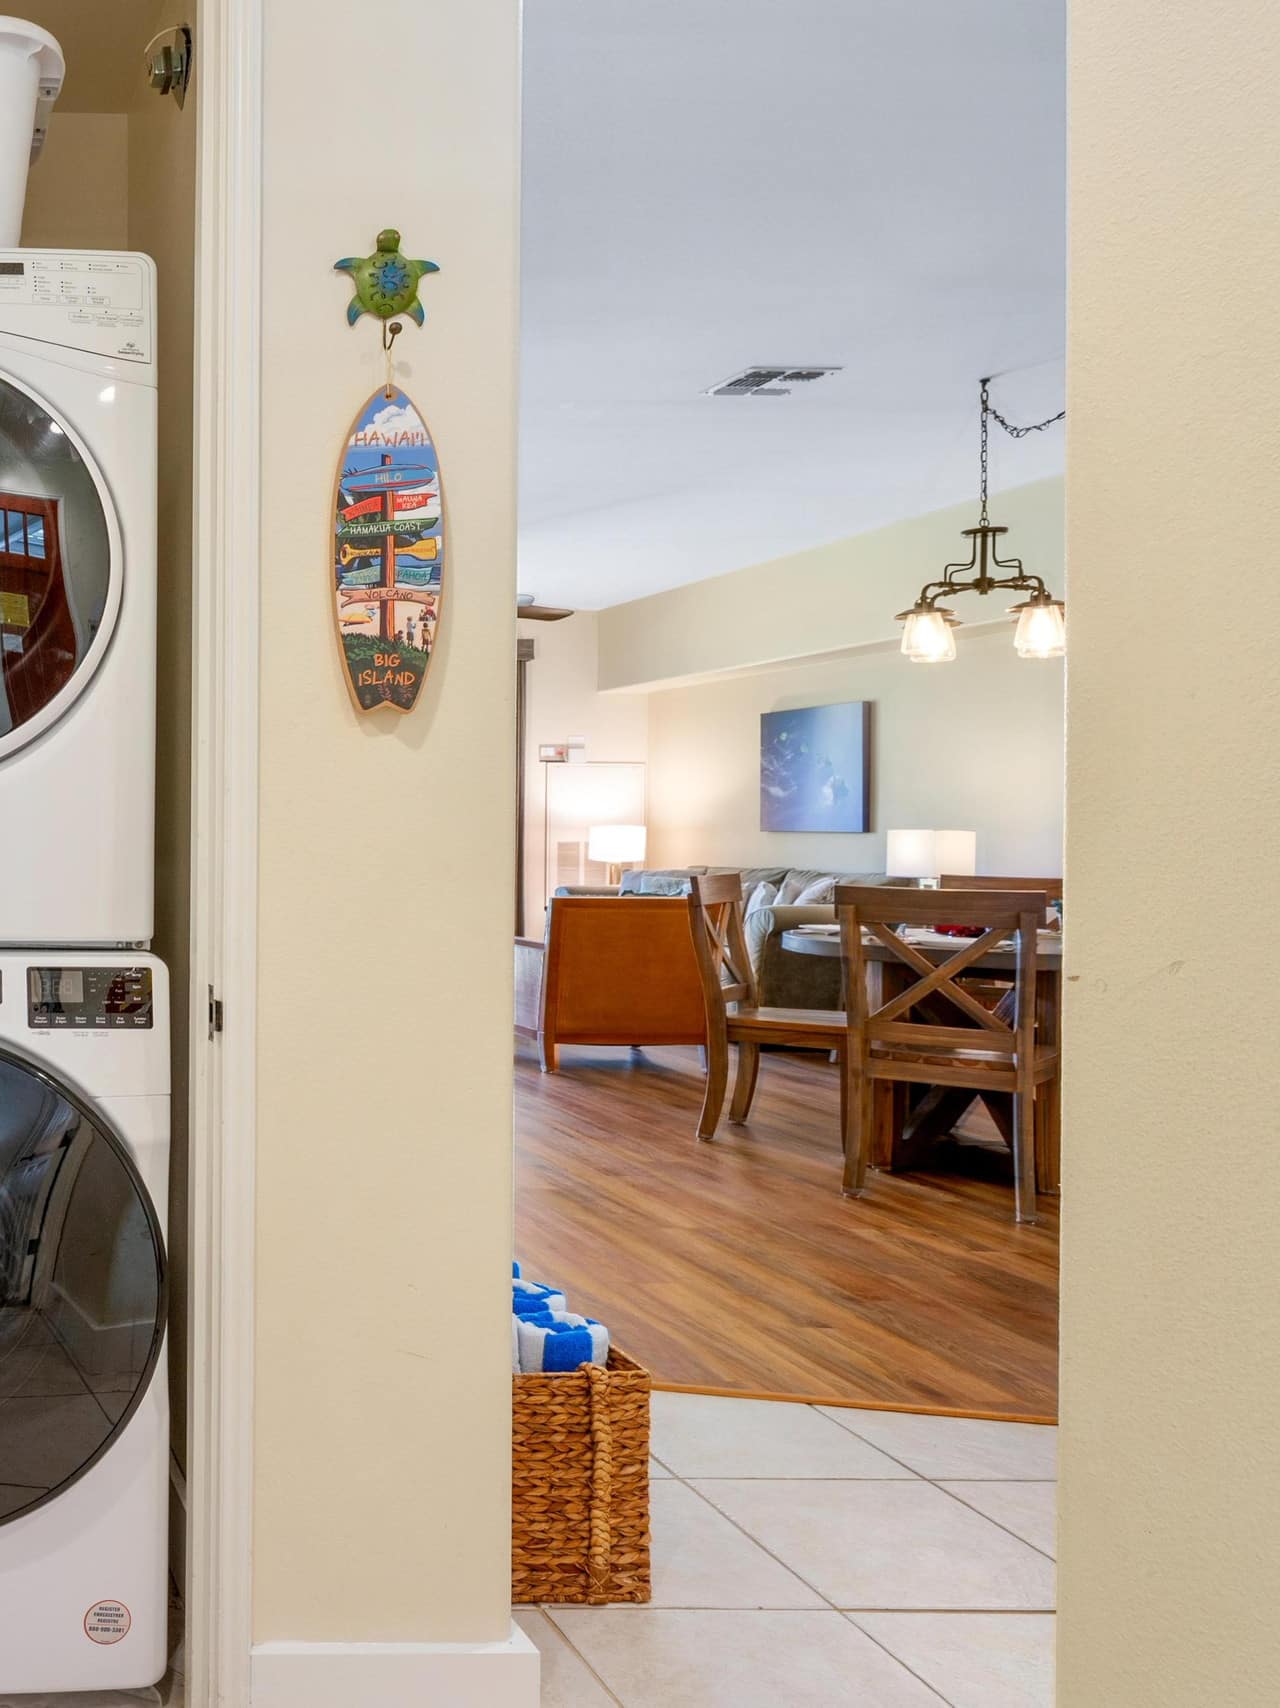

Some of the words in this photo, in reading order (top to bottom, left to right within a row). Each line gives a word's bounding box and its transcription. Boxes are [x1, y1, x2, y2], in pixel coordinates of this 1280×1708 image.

[393, 521, 421, 531] COAST
[364, 589, 414, 600] VOLCANO
[373, 653, 401, 667] BIG
[358, 670, 415, 686] ISLAND
